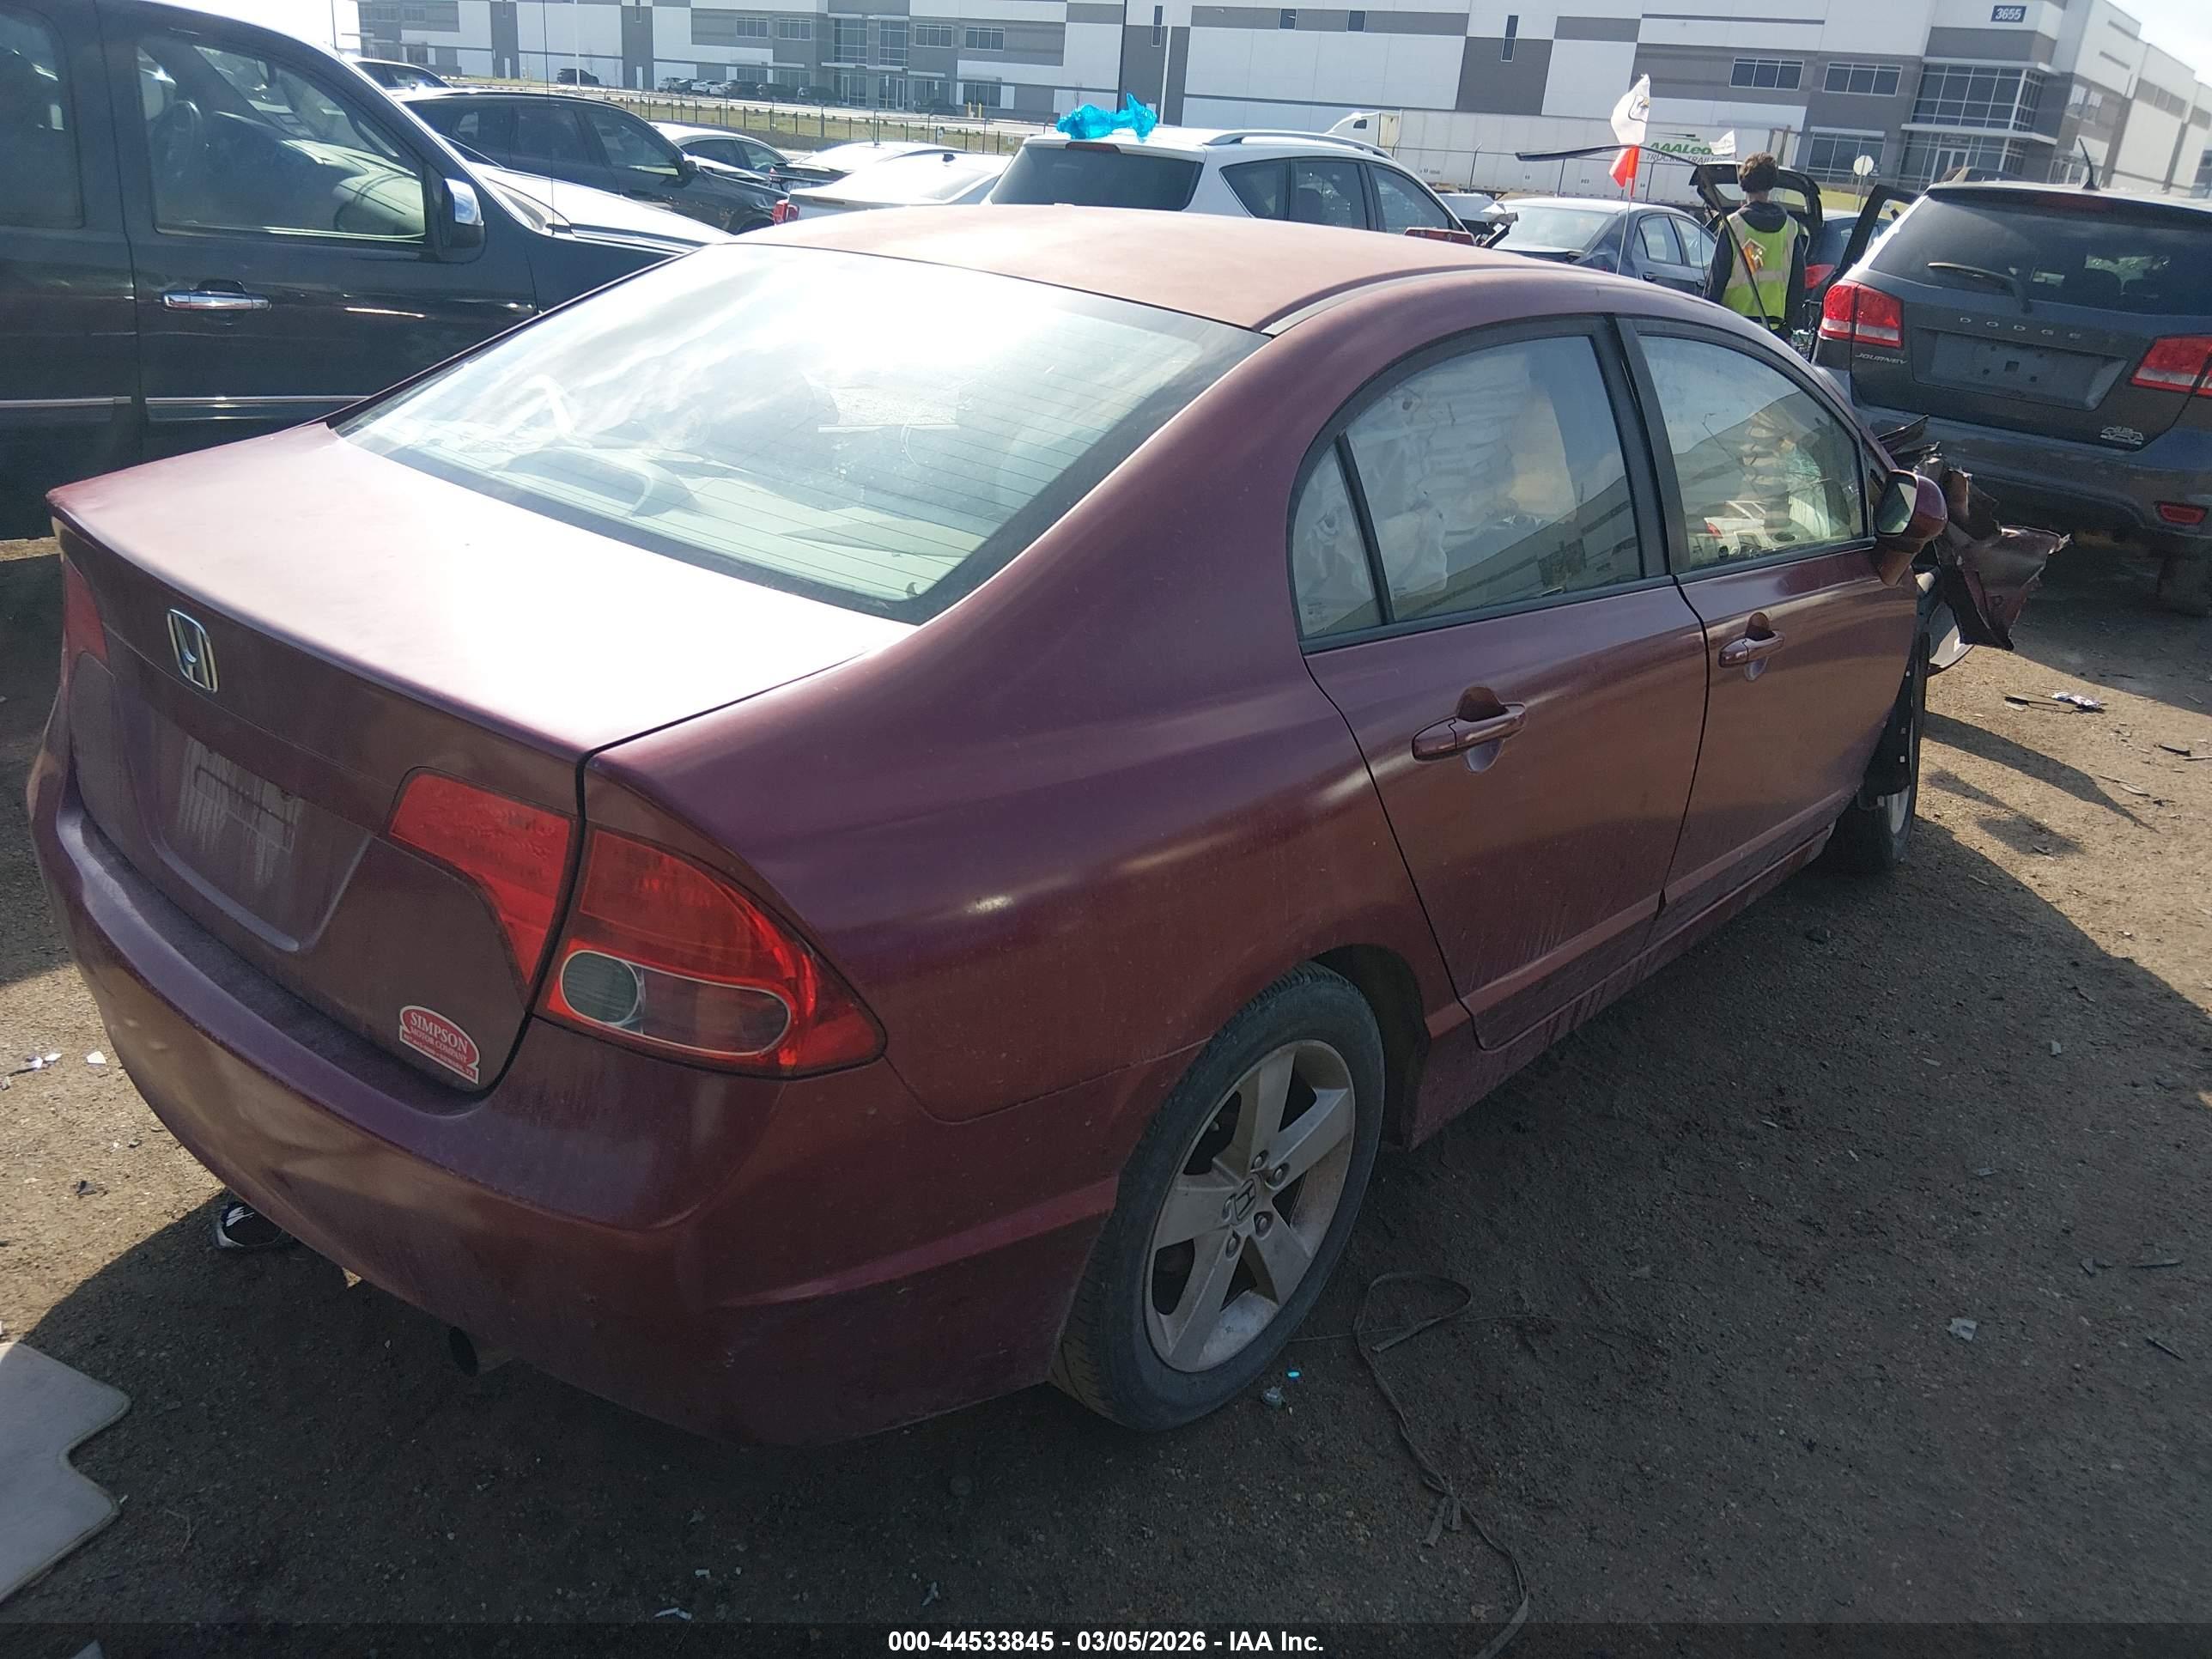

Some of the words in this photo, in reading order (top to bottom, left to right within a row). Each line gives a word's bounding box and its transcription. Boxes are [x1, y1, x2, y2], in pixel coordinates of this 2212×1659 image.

[1995, 7, 2021, 20] 3655
[1960, 317, 2081, 339] DODGE
[1855, 352, 1908, 365] JOURNEY
[410, 1012, 468, 1054] SIMPSON
[410, 1026, 434, 1045] MOTOR
[435, 1040, 468, 1063] COMPANY
